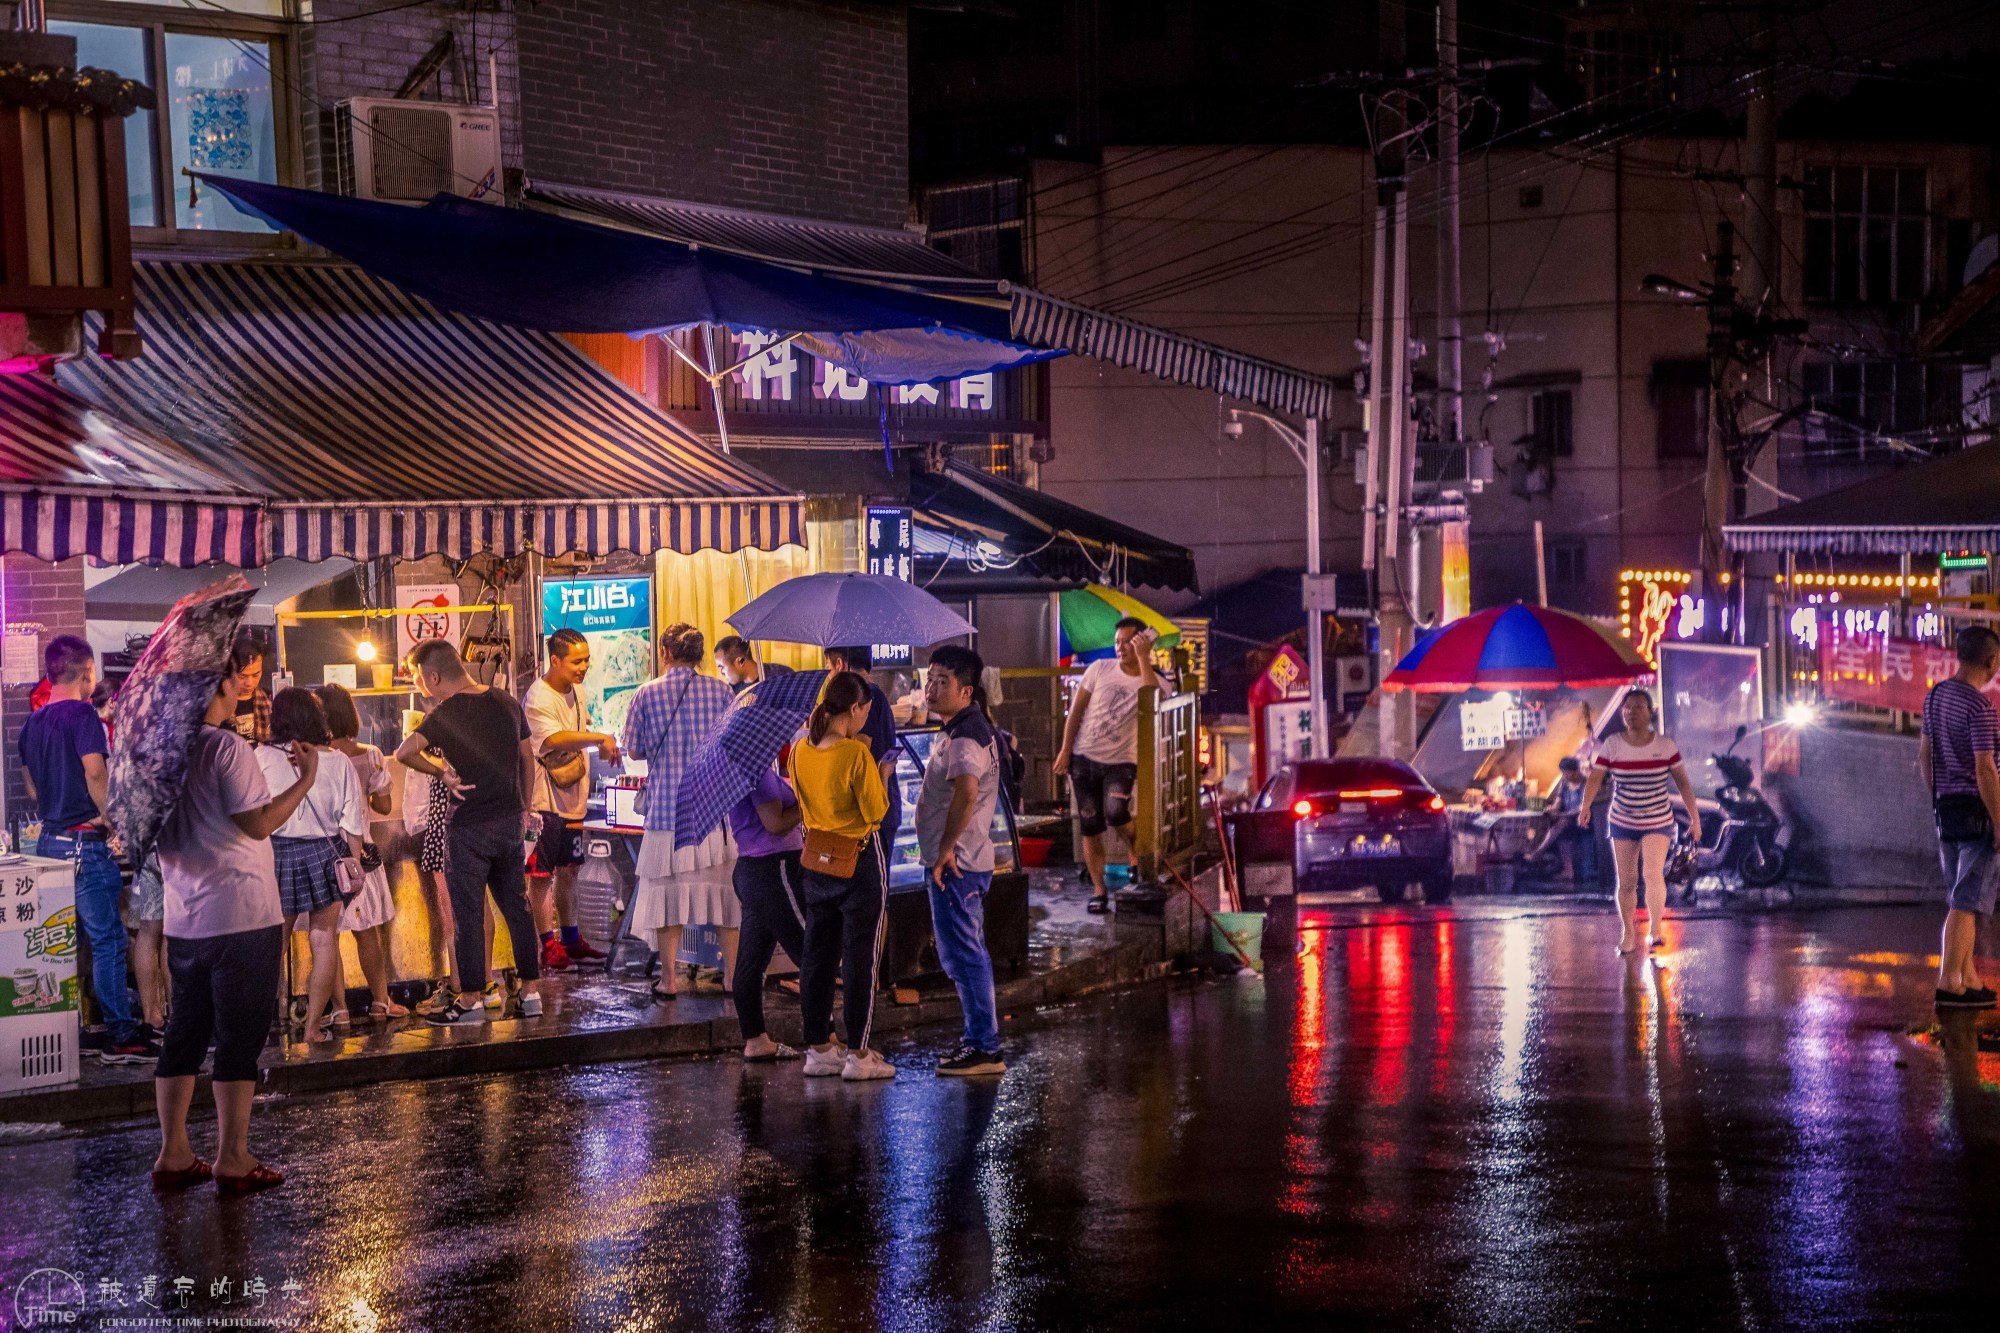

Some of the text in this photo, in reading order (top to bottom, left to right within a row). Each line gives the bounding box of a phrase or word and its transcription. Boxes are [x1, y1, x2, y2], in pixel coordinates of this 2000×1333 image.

[468, 123, 491, 131] GREE
[560, 583, 629, 614] 江小白
